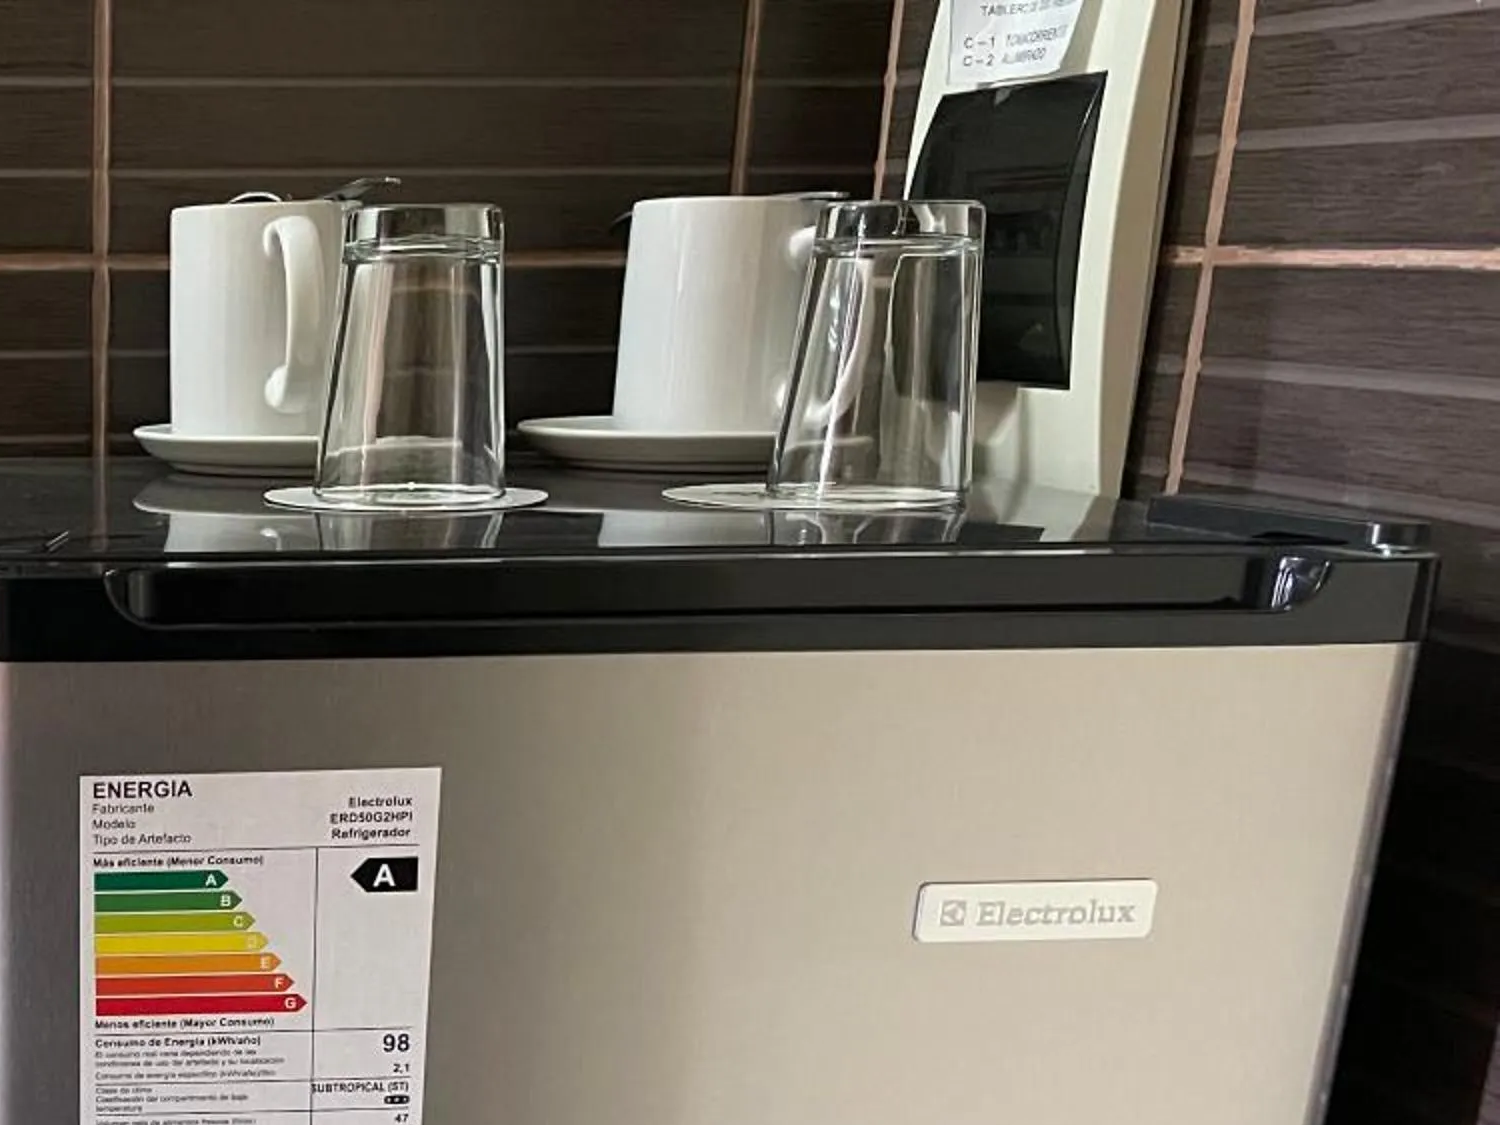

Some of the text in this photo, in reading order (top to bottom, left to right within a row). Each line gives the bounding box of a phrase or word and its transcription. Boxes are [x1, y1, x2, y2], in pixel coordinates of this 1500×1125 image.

[93, 781, 193, 799] ENERGIA
[349, 796, 412, 807] Electrolux
[92, 803, 154, 814] Fabricante
[92, 819, 136, 829] Modelo
[93, 833, 192, 847] Tipo de Artefacto
[332, 828, 411, 840] Refrigerador
[117, 857, 163, 867] eficiente
[207, 855, 263, 865] Consumo)
[205, 873, 217, 886] A
[373, 863, 396, 888] A
[220, 895, 231, 907] B
[976, 898, 1136, 926] Electrolux
[233, 915, 244, 927] C
[261, 957, 270, 969] E
[274, 978, 284, 989] F
[284, 997, 297, 1010] G
[95, 1017, 275, 1030] Menos eficiente (Mayor Consumo)
[95, 1039, 145, 1048] Consumo
[148, 1038, 161, 1047] de
[383, 1033, 410, 1052] 98
[311, 1081, 409, 1094] SUBTROPICAL (ST)
[394, 1113, 409, 1123] 47
